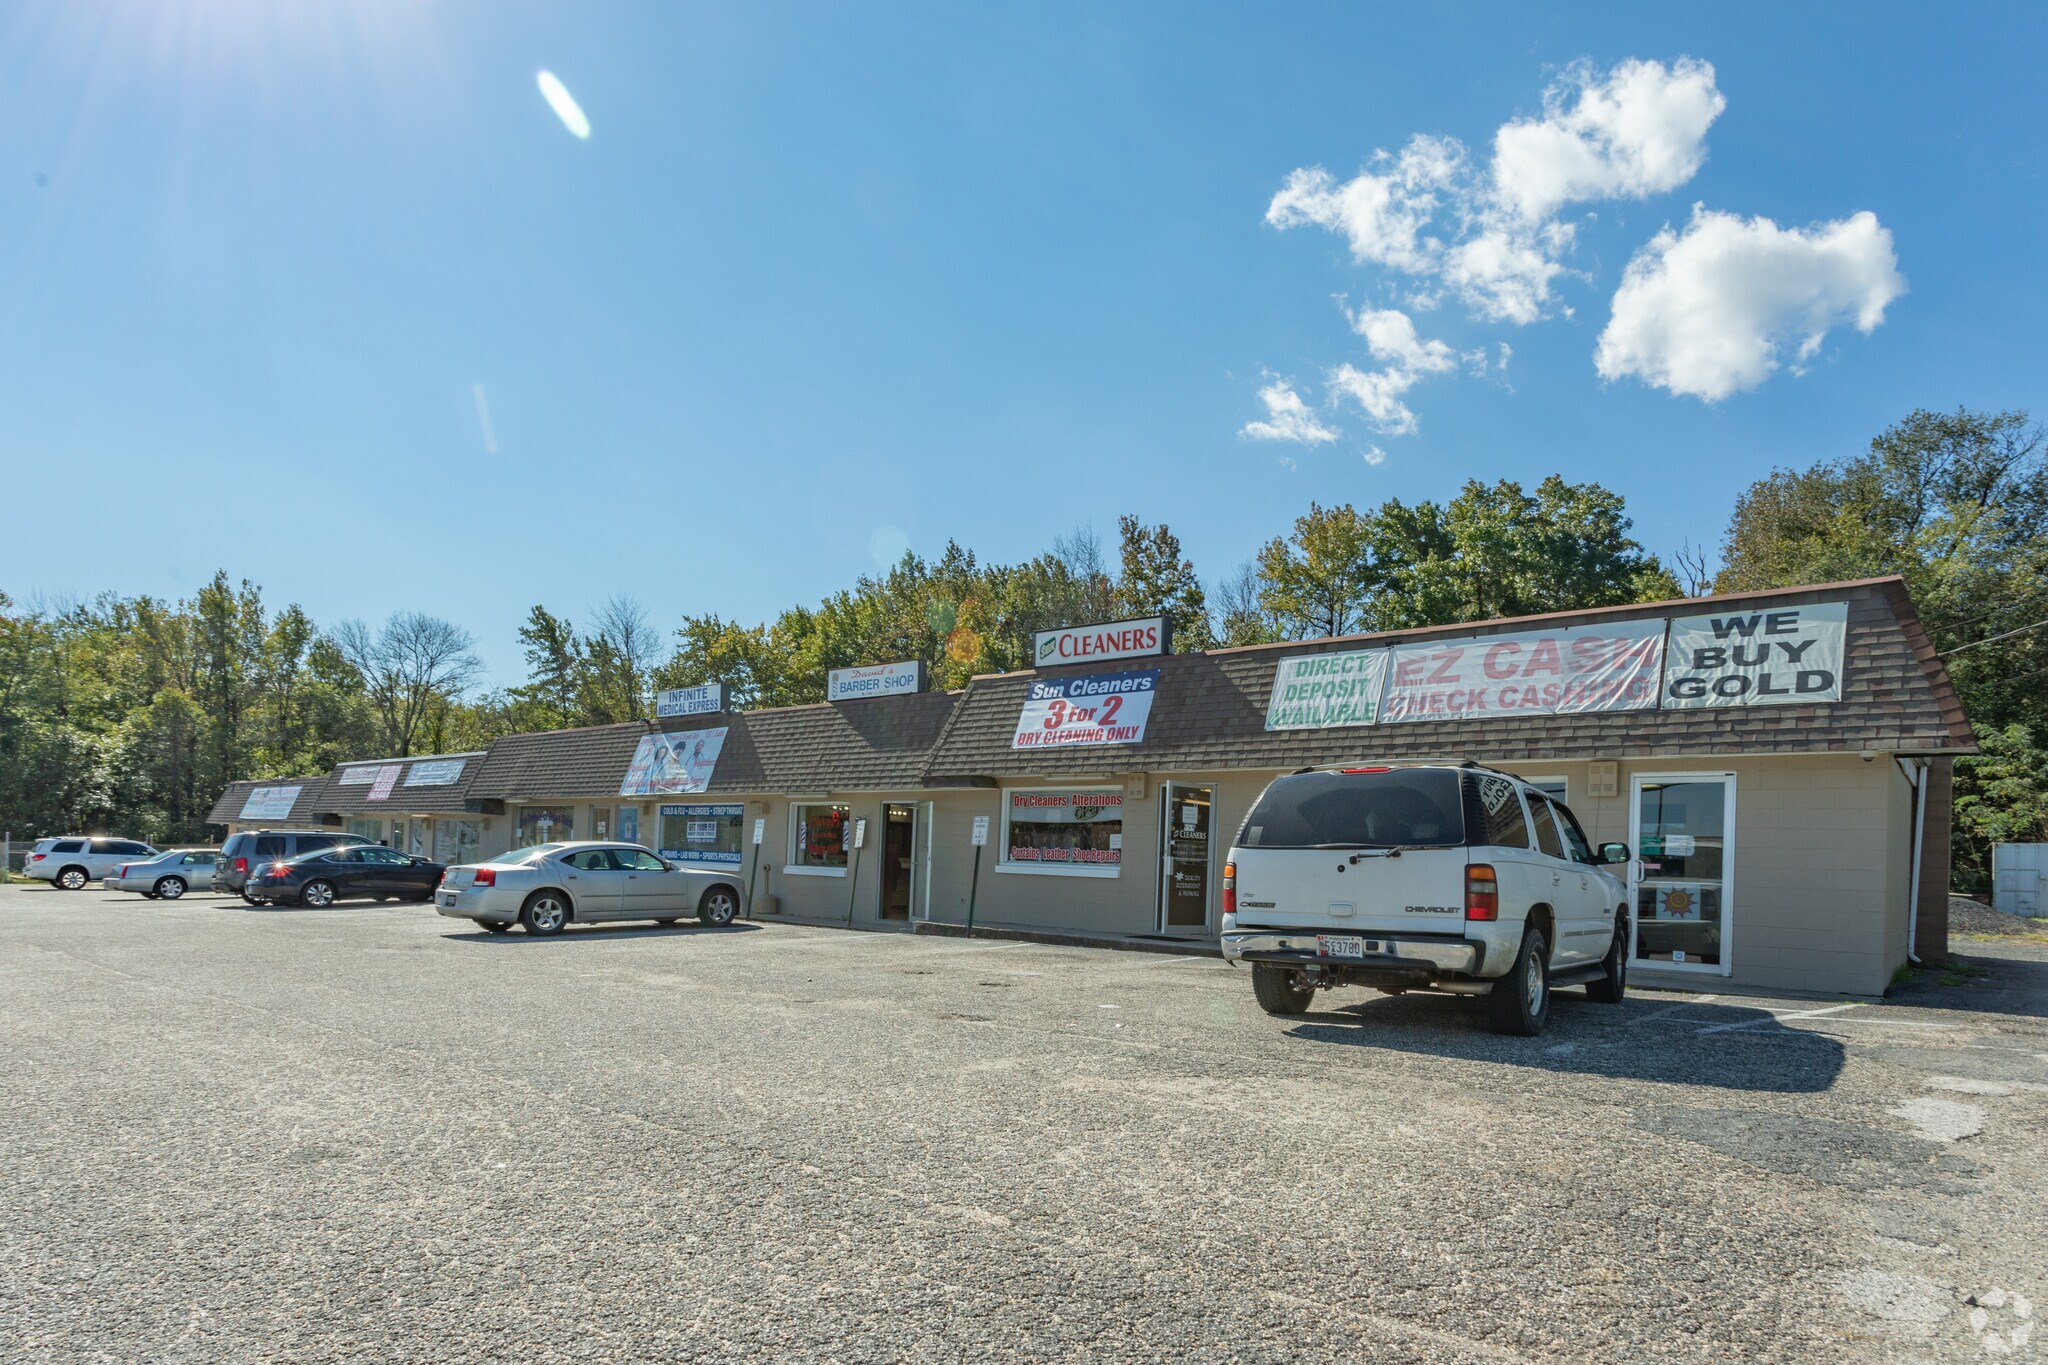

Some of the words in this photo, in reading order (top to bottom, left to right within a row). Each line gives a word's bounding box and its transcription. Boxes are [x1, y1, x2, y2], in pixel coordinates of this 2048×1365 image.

[1709, 611, 1800, 640] WE
[1058, 627, 1157, 658] CLEANERS
[1393, 647, 1466, 689] EZ
[1482, 635, 1655, 681] CASH
[1693, 639, 1818, 670] BUY
[850, 666, 895, 679] David's
[1295, 654, 1370, 678] DIRECT
[840, 679, 880, 693] BARBER
[884, 675, 915, 689] SHOP
[1031, 683, 1065, 700] Sun
[1069, 676, 1152, 696] Cleaners
[1284, 677, 1371, 702] DEPOSIT
[1668, 669, 1835, 700] GOLD
[668, 687, 708, 703] INFINITE
[1387, 686, 1489, 716] CHECK
[1497, 675, 1651, 709] CASHING
[658, 703, 687, 716] MEDICAL
[688, 699, 719, 714] EXPRESS
[1043, 699, 1067, 730] 3
[1067, 706, 1098, 723] For
[1098, 695, 1124, 726] 2
[1268, 701, 1377, 727] AVAILABLE
[1017, 731, 1043, 746] DRY
[1043, 727, 1105, 744] CLEANING
[1106, 725, 1140, 741] ONLY
[662, 807, 674, 815] COLD
[677, 807, 686, 815] FLU
[688, 806, 710, 815] ALLERGIES
[712, 806, 726, 815] STREP
[726, 806, 743, 815] THROAT
[1013, 795, 1028, 808] Dry
[1029, 794, 1068, 807] Cleaners
[1071, 794, 1122, 806] Alterations
[688, 823, 696, 831] GET
[1179, 830, 1207, 840] CLEANERS
[661, 850, 678, 858] SPRAINS
[680, 851, 688, 859] LAB
[688, 851, 700, 859] WORK
[702, 852, 718, 860] SPORTS
[718, 852, 741, 861] PHYSICALS
[1011, 845, 1041, 860] Curtains
[1042, 847, 1070, 860] Leather
[1072, 848, 1091, 861] Shoe
[1091, 849, 1121, 863] Repairs
[1404, 906, 1461, 914] CHEVROLET
